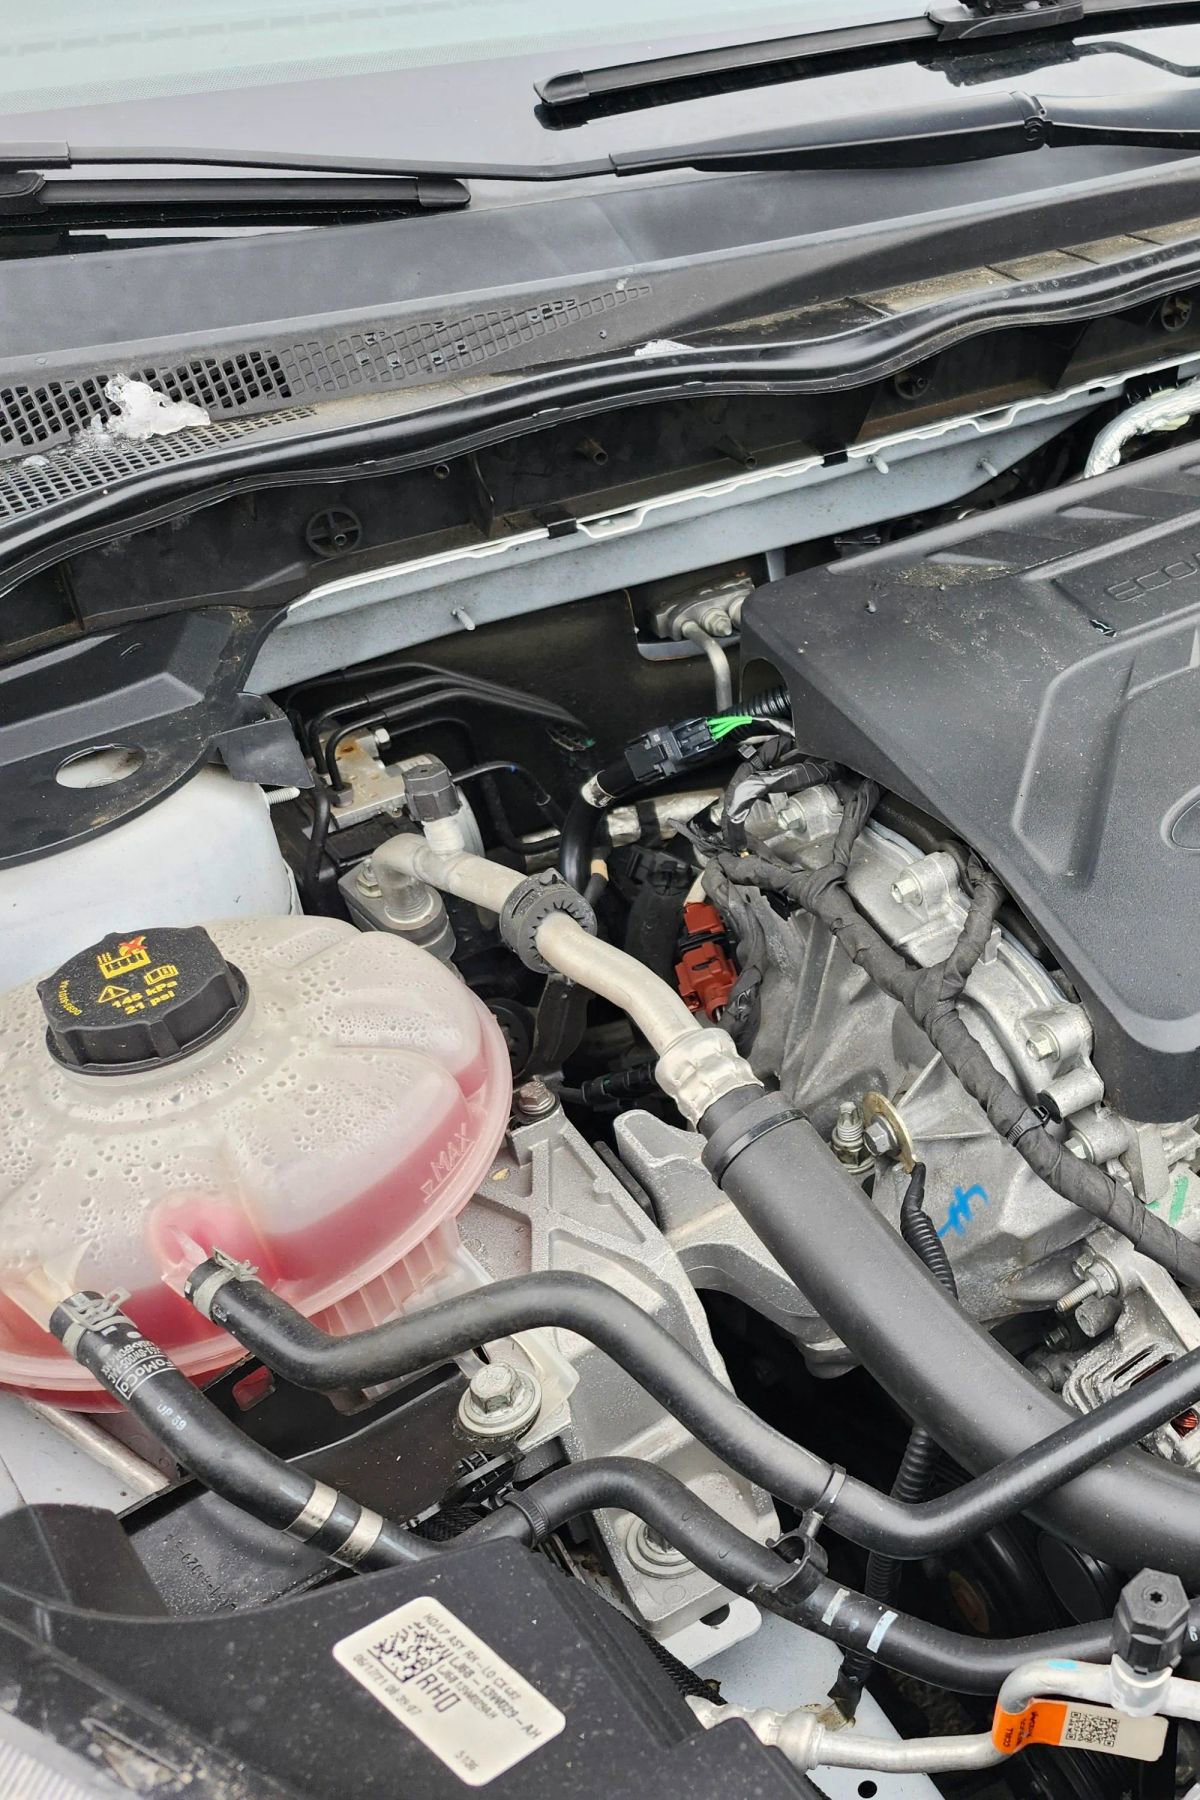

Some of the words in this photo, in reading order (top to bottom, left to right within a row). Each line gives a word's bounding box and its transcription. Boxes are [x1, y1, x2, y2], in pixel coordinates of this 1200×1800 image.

[111, 991, 143, 1009] 145
[144, 979, 178, 996] kPa
[124, 1001, 145, 1014] 21
[149, 989, 175, 1006] psi
[424, 1121, 474, 1183] MAX
[118, 1358, 173, 1393] FoMoCo
